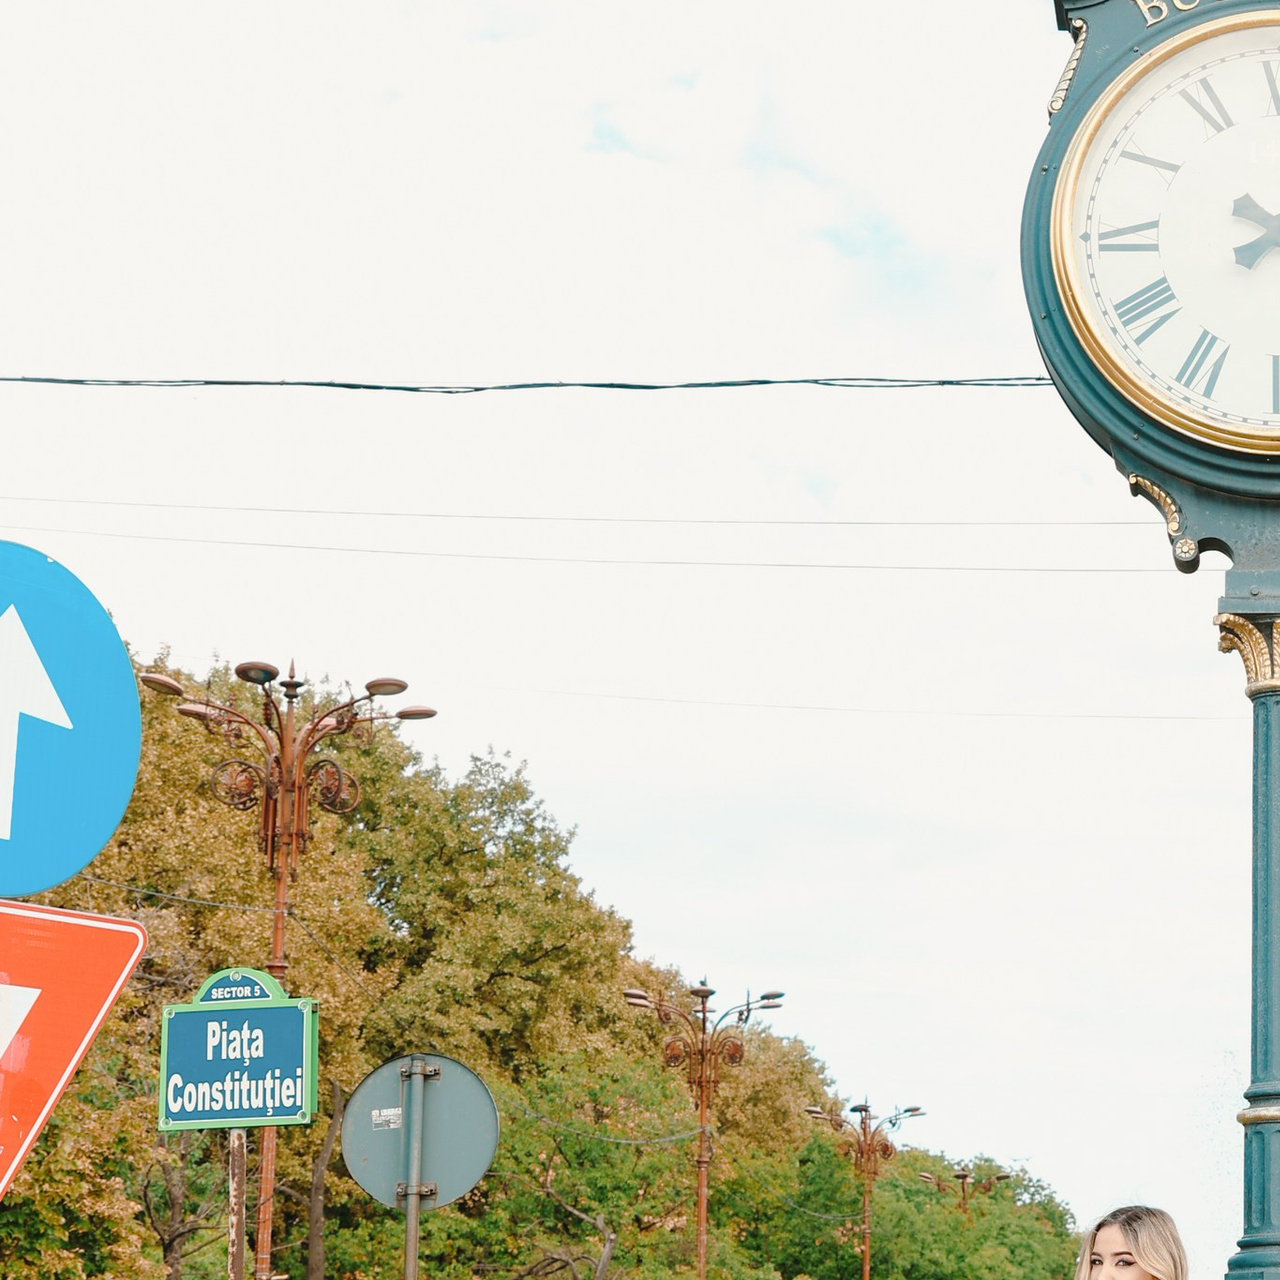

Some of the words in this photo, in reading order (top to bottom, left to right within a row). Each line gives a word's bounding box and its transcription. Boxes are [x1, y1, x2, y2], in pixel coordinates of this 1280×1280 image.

[1171, 73, 1240, 144] XI
[1097, 212, 1162, 260] IX
[1108, 269, 1184, 352] VIII
[1169, 324, 1232, 404] VII
[211, 986, 252, 1000] SECTOR
[254, 985, 261, 996] 5
